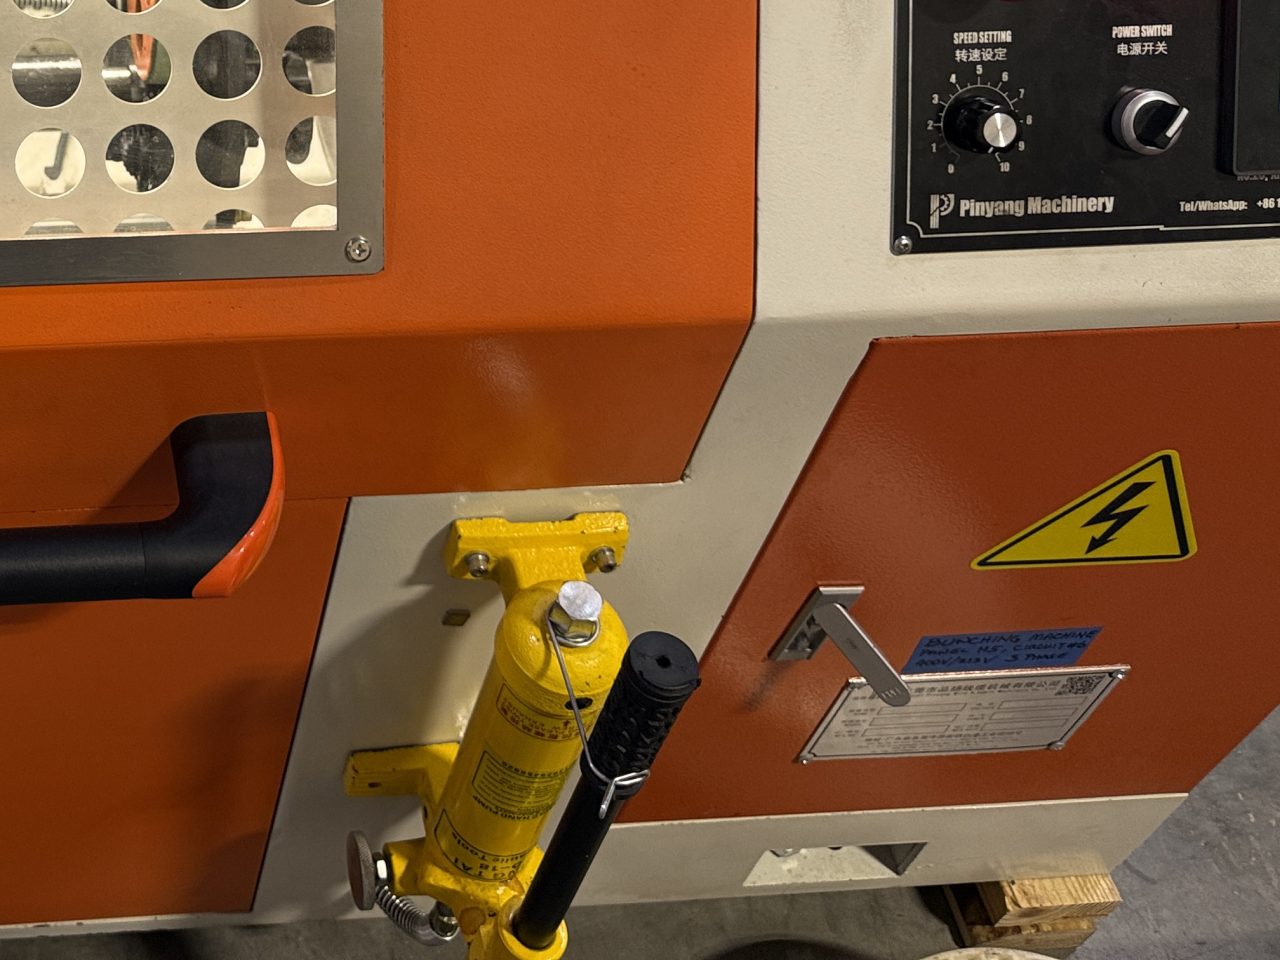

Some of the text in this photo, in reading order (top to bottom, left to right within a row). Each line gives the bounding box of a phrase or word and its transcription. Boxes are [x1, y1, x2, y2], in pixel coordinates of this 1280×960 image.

[953, 30, 1013, 44] SPEED SETTING
[1112, 24, 1173, 39] POWER SWITCH
[1116, 41, 1168, 56] 电源开关
[954, 47, 1008, 62] 转速设定
[976, 64, 983, 75] 5
[949, 73, 957, 84] 4
[1002, 71, 1009, 82] 6
[931, 93, 939, 105] 3
[1018, 88, 1025, 99] 7
[926, 119, 934, 130] 2
[1025, 114, 1033, 125] 8
[930, 142, 937, 153] 1
[1018, 140, 1025, 151] 9
[947, 163, 955, 174] 0
[999, 161, 1010, 172] 10
[959, 195, 1115, 218] Pinyang Machinery
[1179, 200, 1248, 212] Tel/WhatsApp:
[1256, 197, 1276, 209] +86
[1027, 629, 1099, 641] MACHINE
